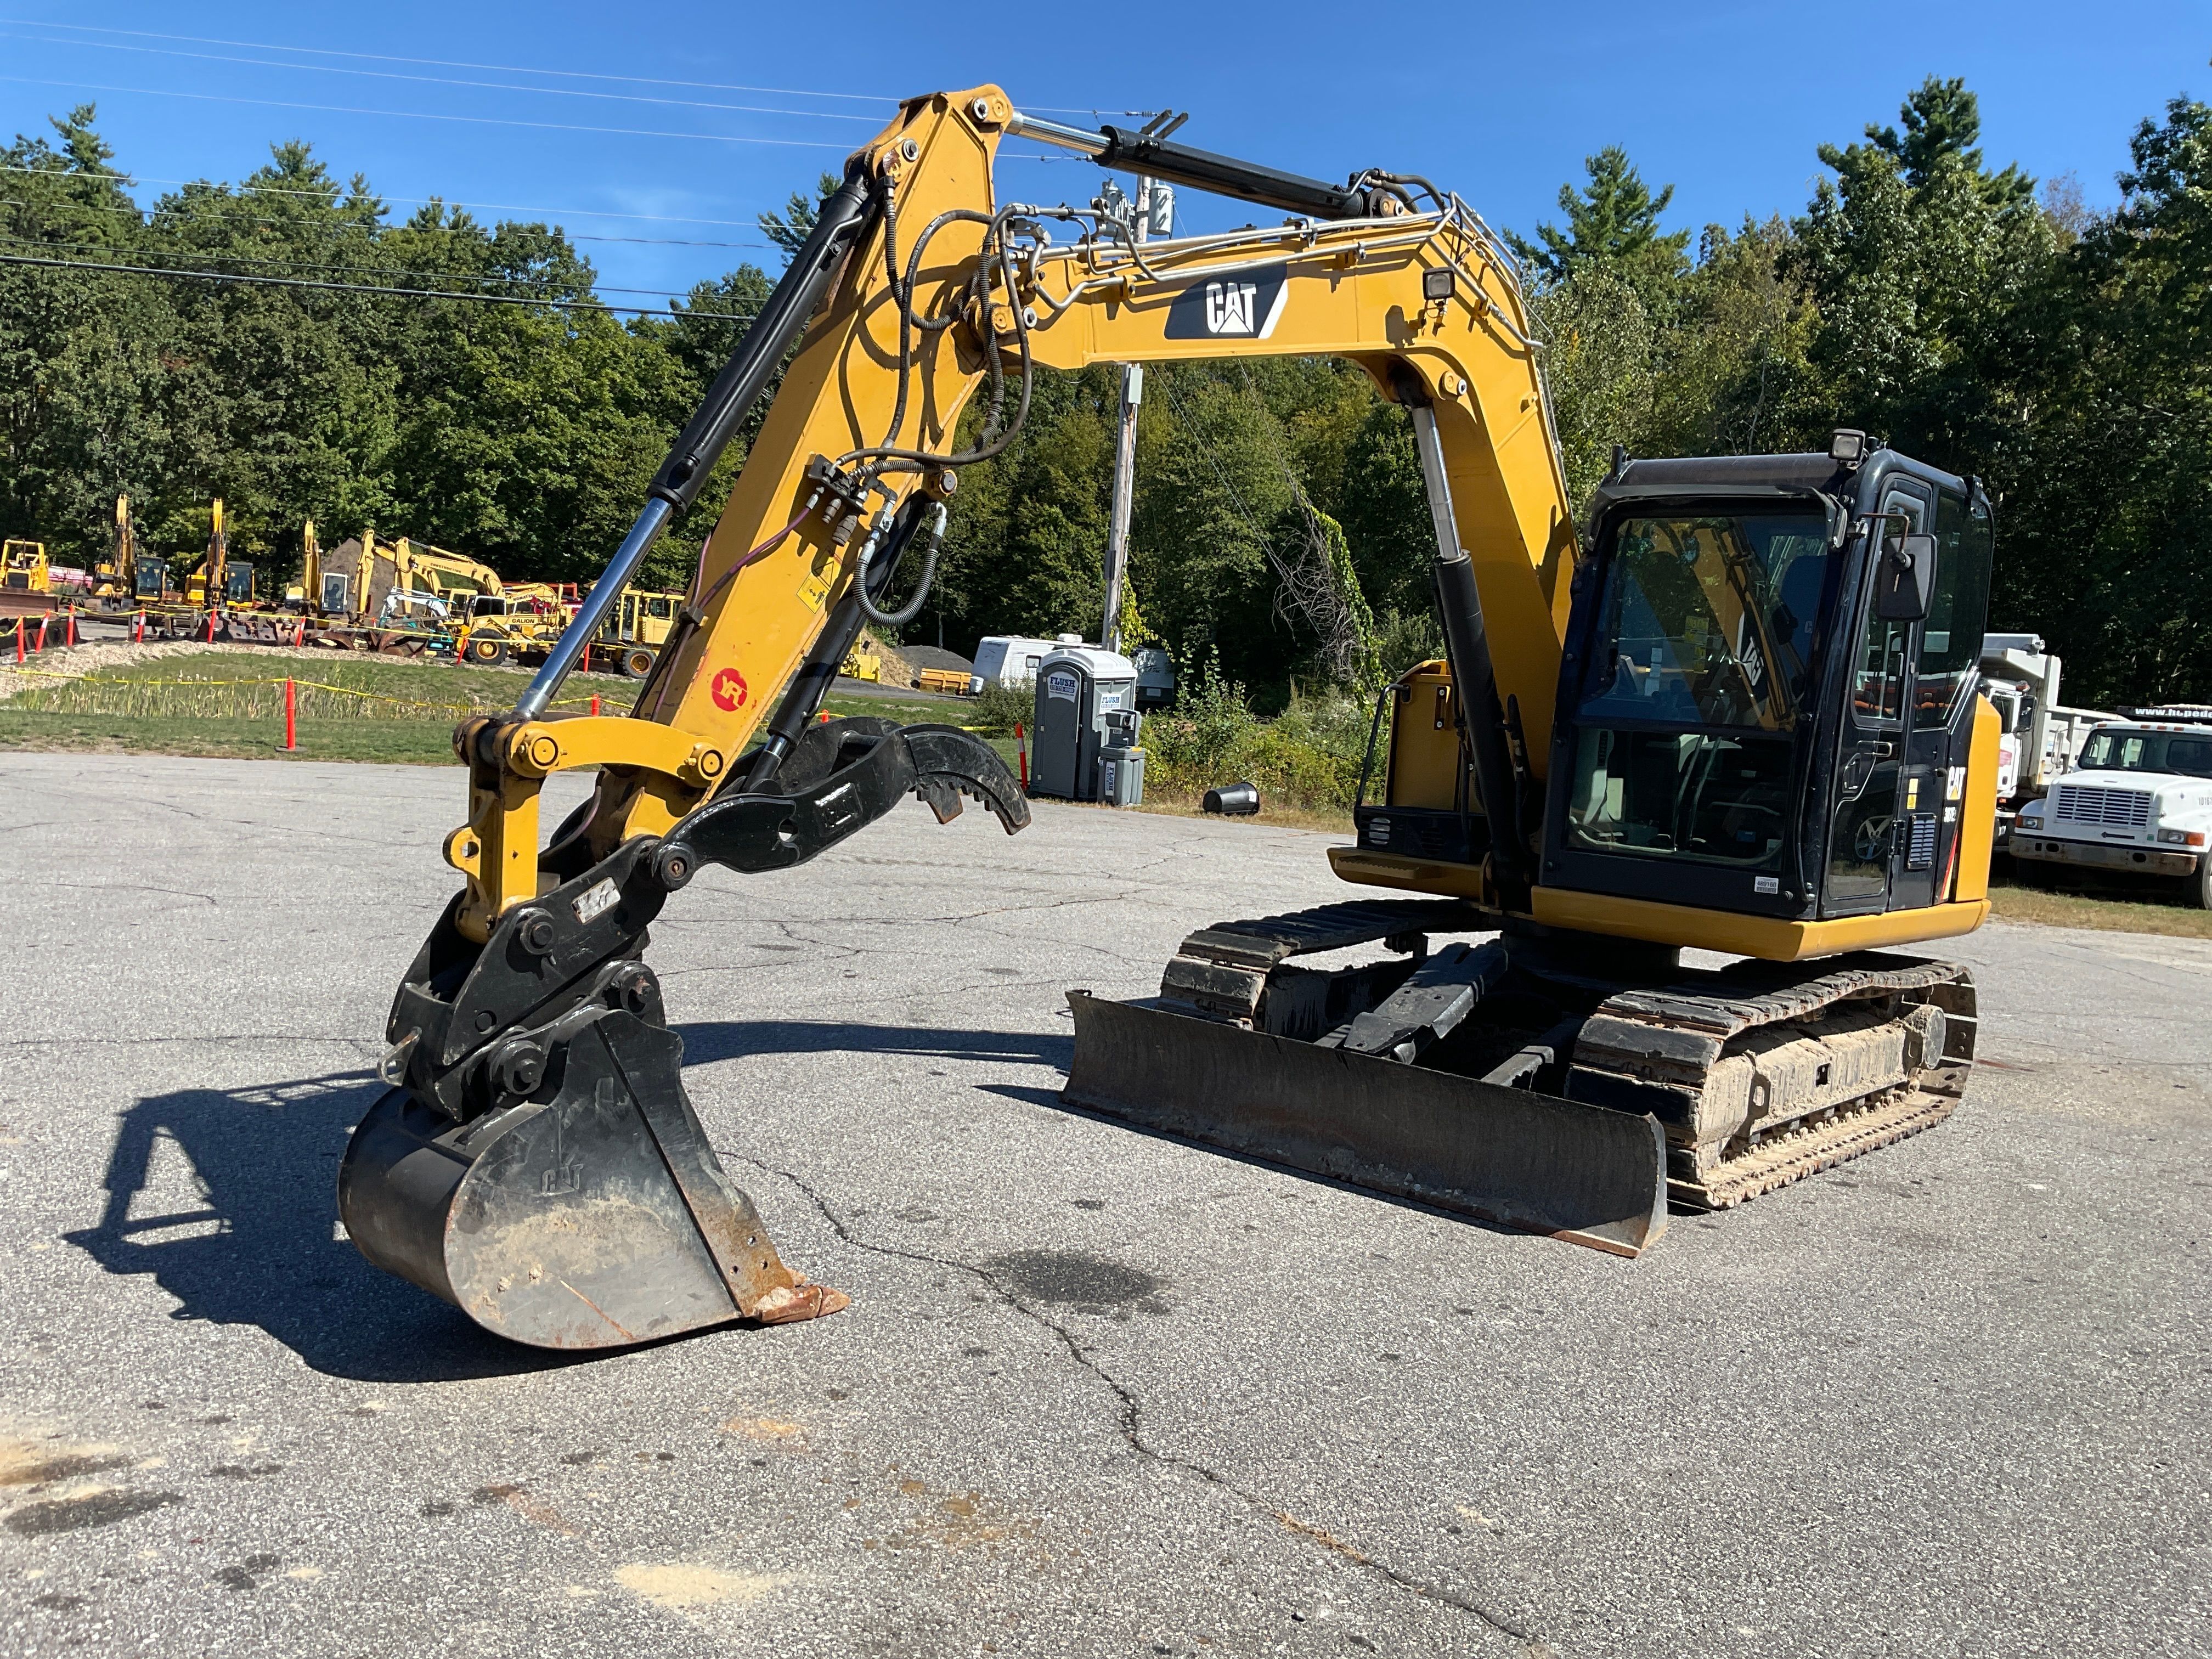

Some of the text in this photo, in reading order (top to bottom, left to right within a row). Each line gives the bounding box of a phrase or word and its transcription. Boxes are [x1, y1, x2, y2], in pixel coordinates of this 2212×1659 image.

[1206, 281, 1256, 333] CAT
[1049, 676, 1075, 687] FLUSH
[1946, 766, 1966, 800] CAT
[541, 1163, 584, 1197] CAT
